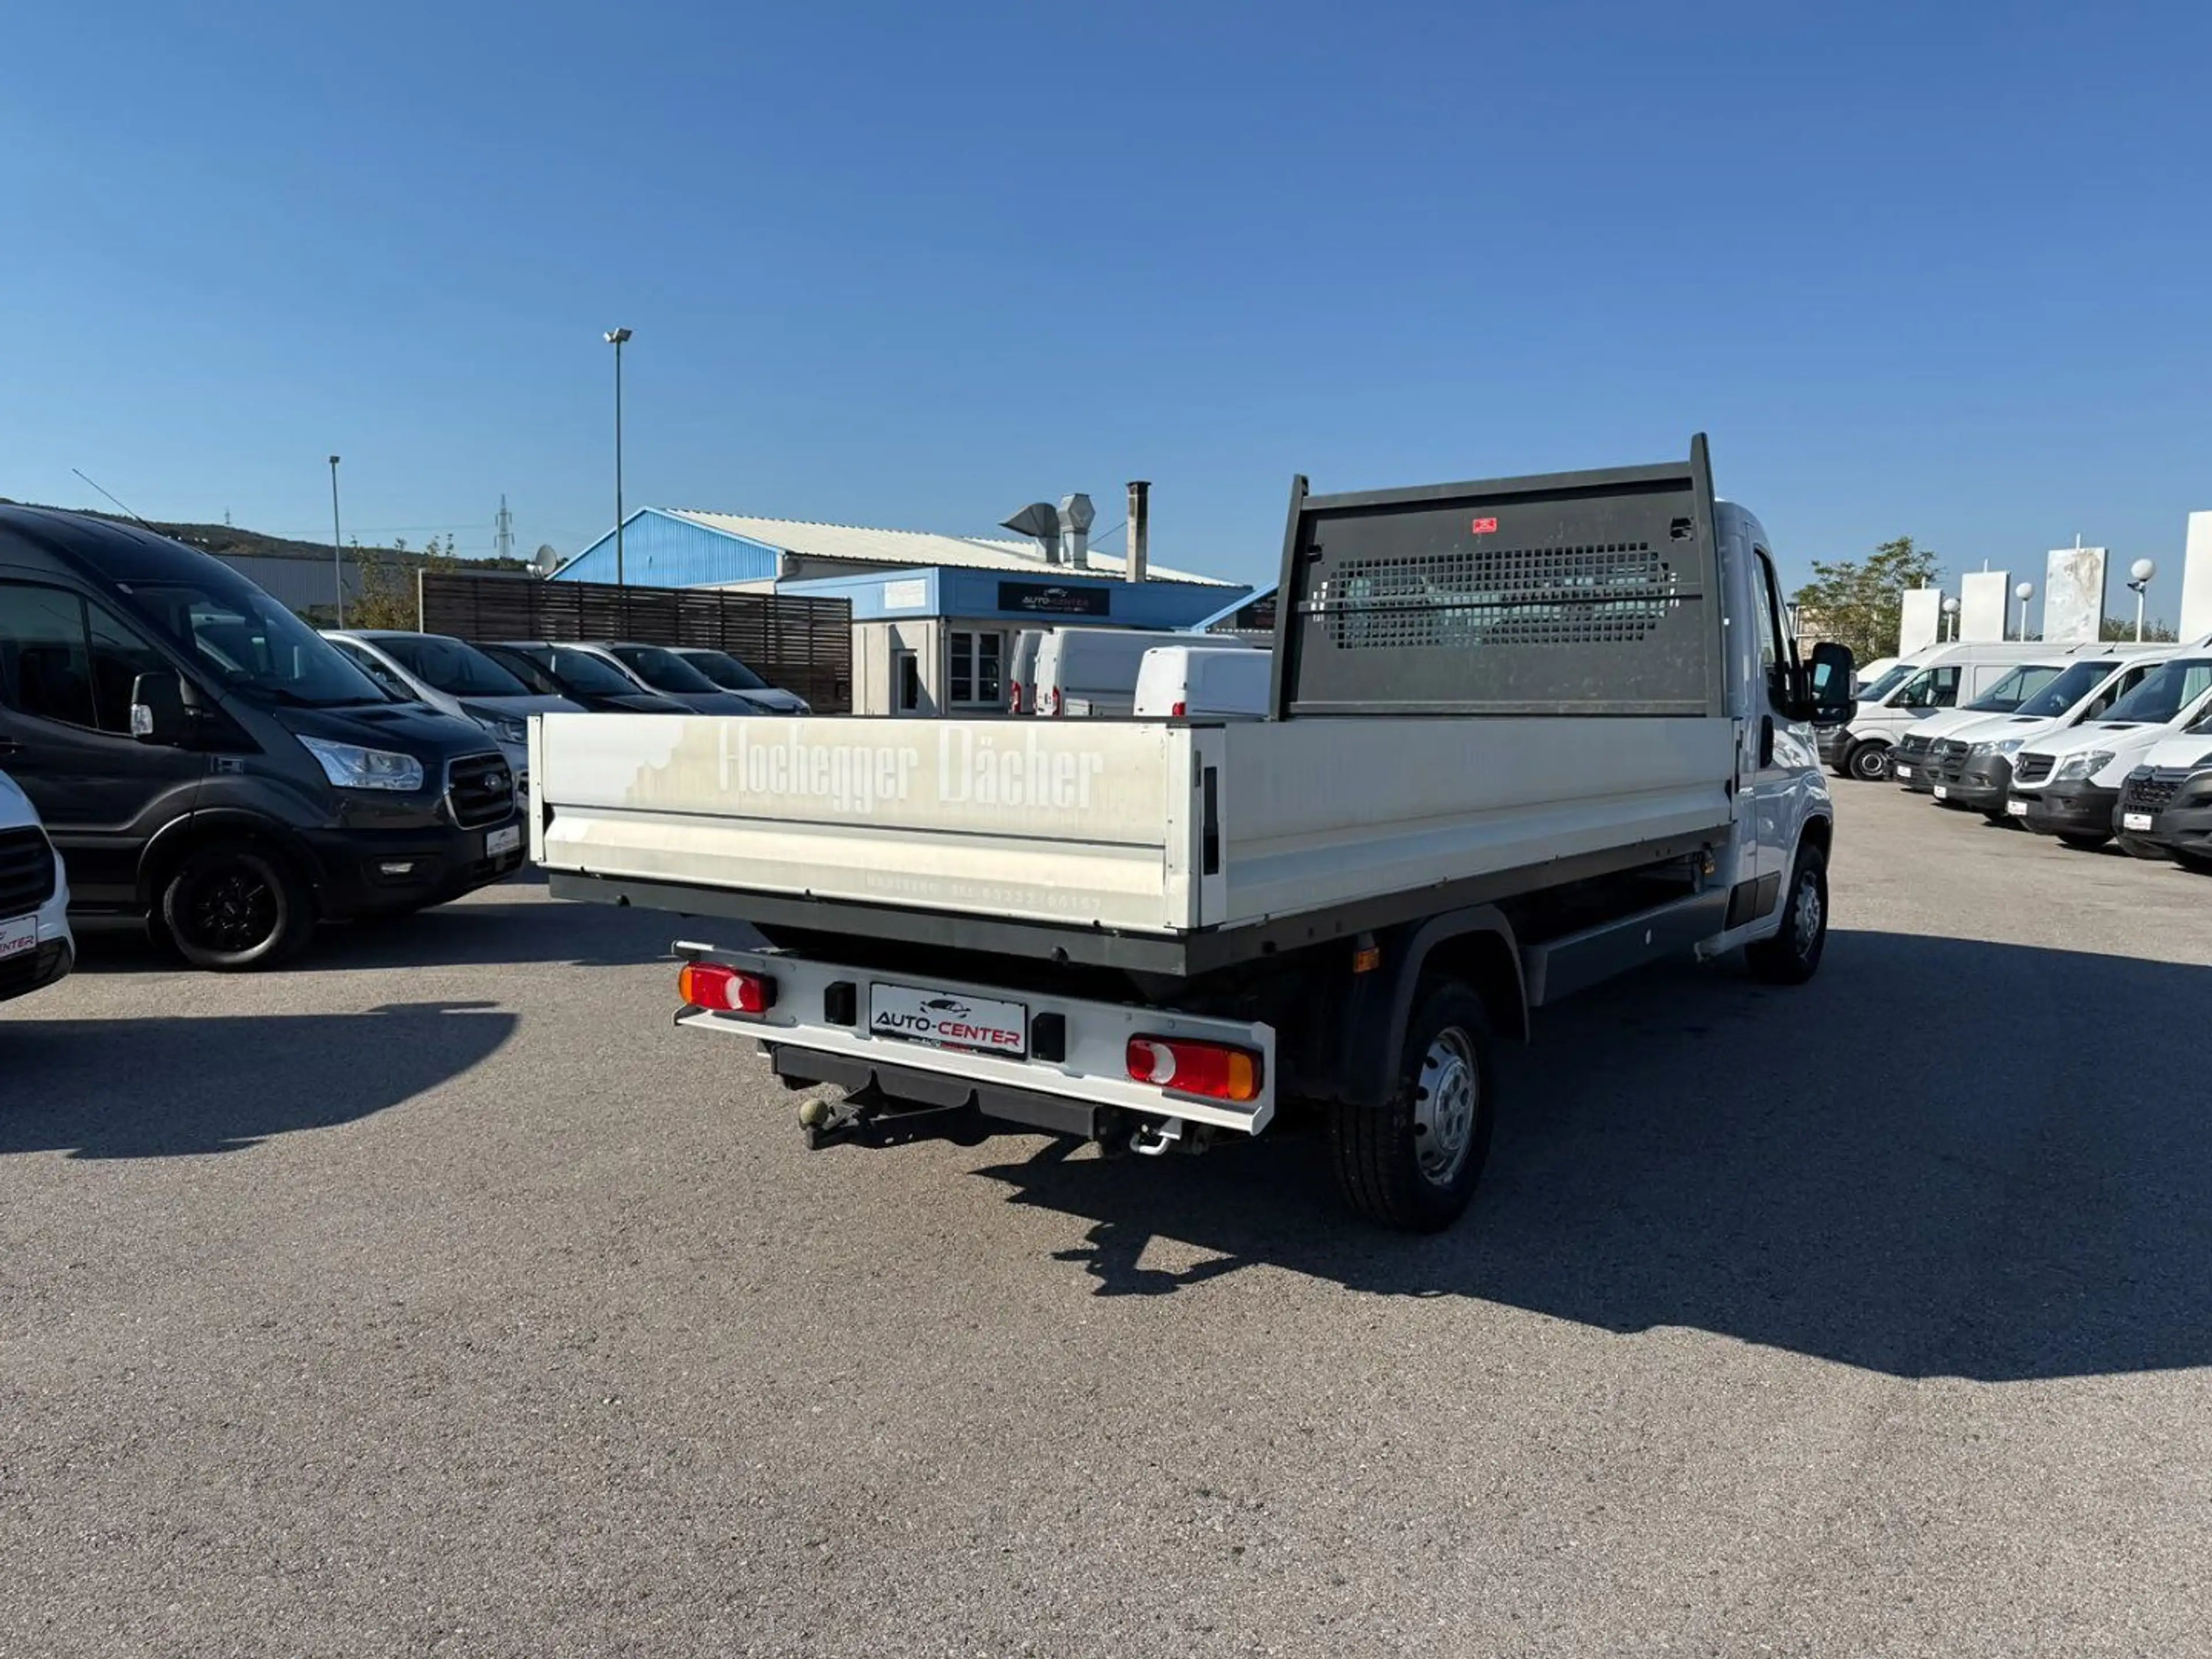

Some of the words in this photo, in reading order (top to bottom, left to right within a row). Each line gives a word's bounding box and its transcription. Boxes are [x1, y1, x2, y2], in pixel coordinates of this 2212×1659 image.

[719, 722, 918, 814] Hochegger
[939, 725, 1103, 809] Dächer
[875, 1011, 1021, 1047] AUTO-CENTER
